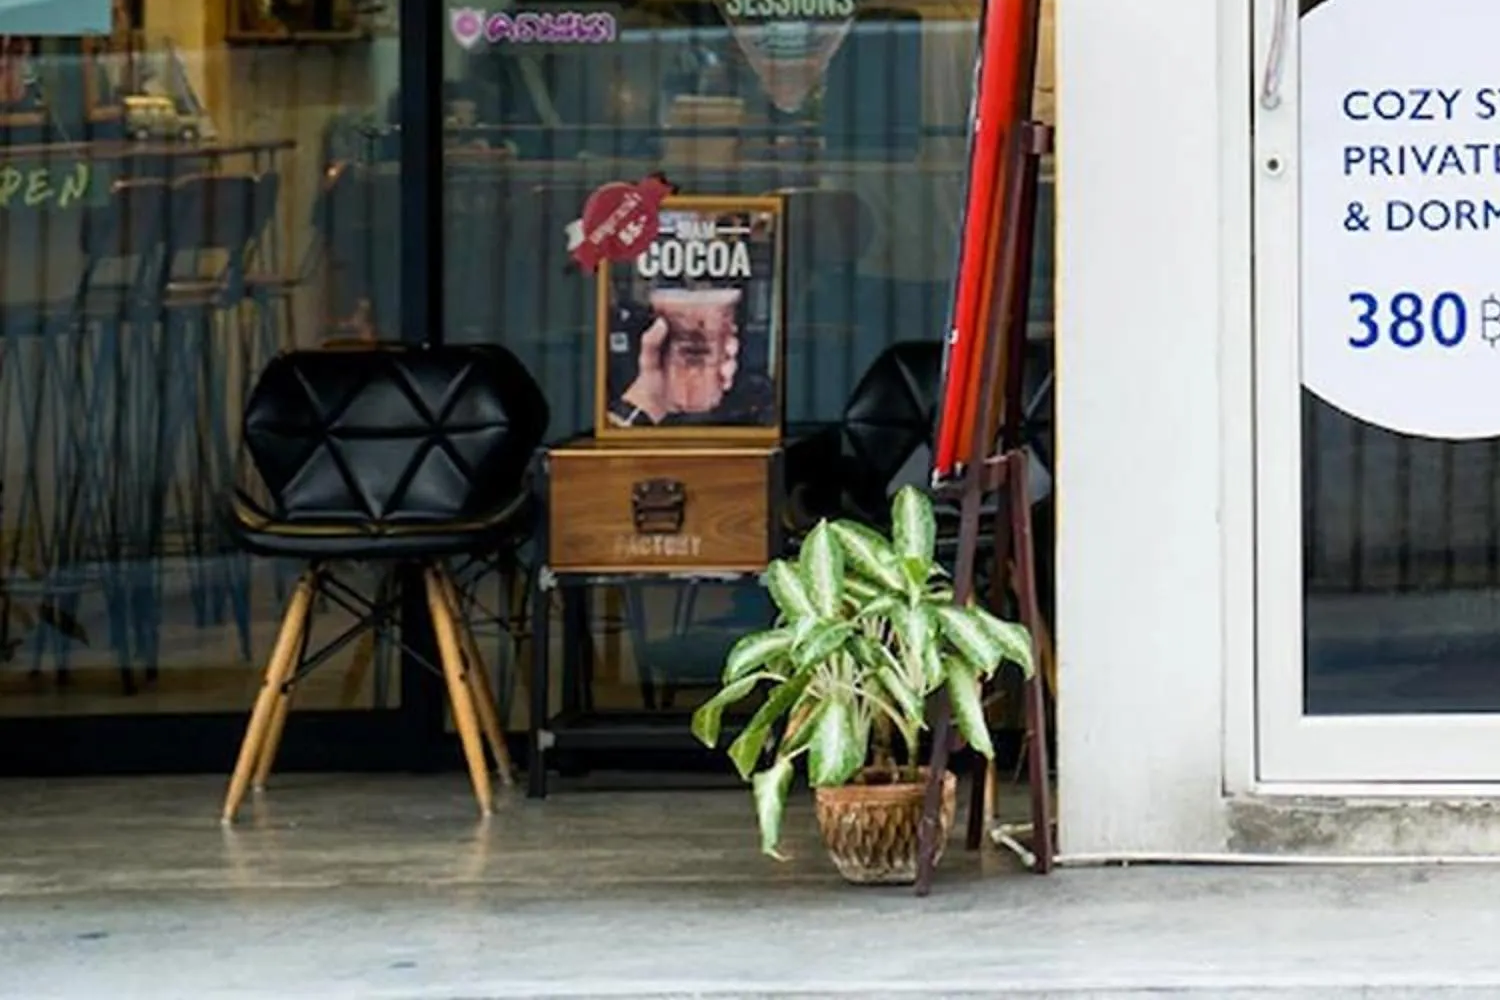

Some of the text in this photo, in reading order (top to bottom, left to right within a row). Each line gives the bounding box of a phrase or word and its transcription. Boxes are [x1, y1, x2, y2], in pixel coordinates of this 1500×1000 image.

[1343, 89, 1461, 120] COZY
[1343, 201, 1370, 231] &
[637, 241, 751, 277] COCOA
